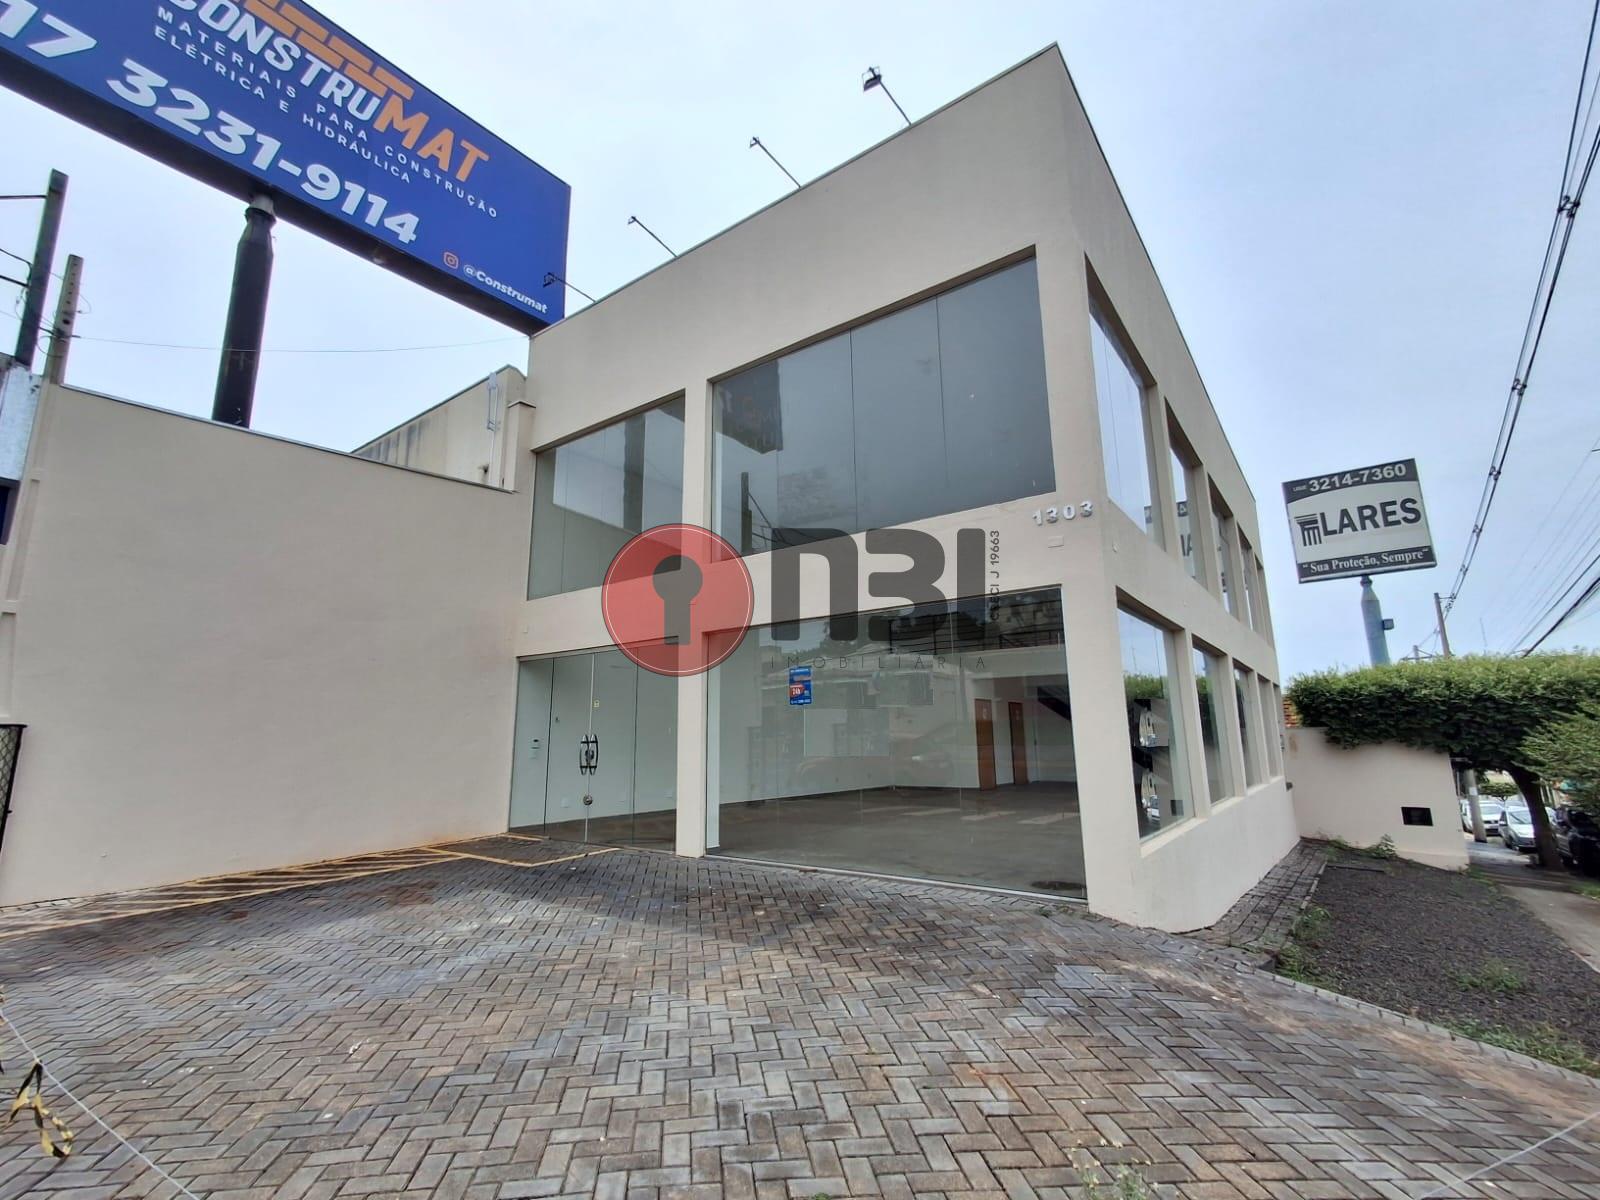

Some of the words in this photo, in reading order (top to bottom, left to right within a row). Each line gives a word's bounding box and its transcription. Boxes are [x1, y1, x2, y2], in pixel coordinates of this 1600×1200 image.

[154, 25, 265, 99] ELÉTRICA
[279, 99, 289, 113] E
[302, 113, 411, 184] HIDRÁULICA
[157, 6, 296, 98] MATERIAIS
[316, 103, 368, 141] PARA
[384, 145, 497, 218] CONSTRUÇÃO
[107, 58, 420, 244] 3231-9114
[463, 264, 548, 314] @Construmat
[1309, 463, 1407, 492] 3214-7360
[1033, 500, 1094, 526] 1303
[1320, 498, 1422, 537] LARES
